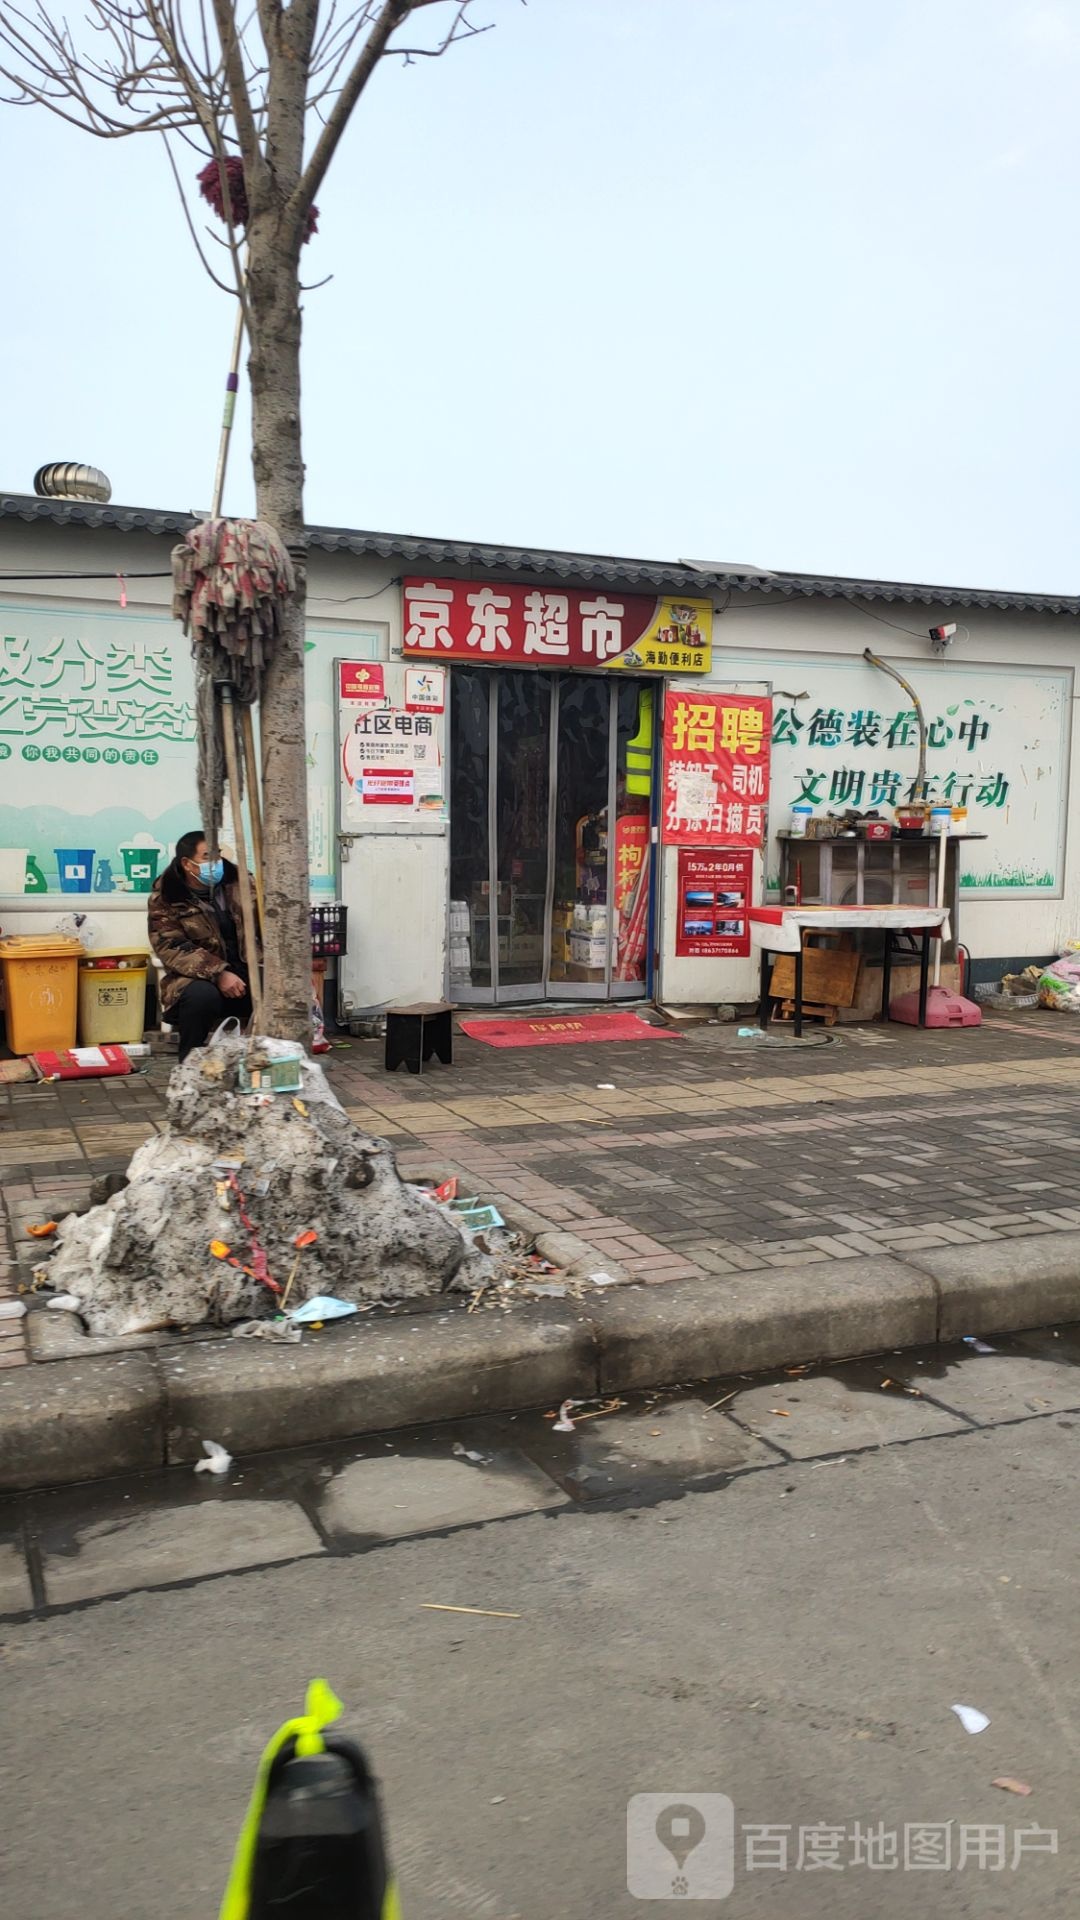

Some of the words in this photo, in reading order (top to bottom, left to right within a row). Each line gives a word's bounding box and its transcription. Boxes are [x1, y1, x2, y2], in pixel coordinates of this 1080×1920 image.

[405, 583, 624, 660] 京东超市
[646, 650, 704, 667] 海勤便利店
[354, 715, 432, 736] 社区电商
[673, 702, 764, 755] 招聘
[772, 706, 990, 752] 公德装在心中
[24, 746, 157, 766] 你我共同的责任
[788, 768, 1010, 808] 文明贵在行动
